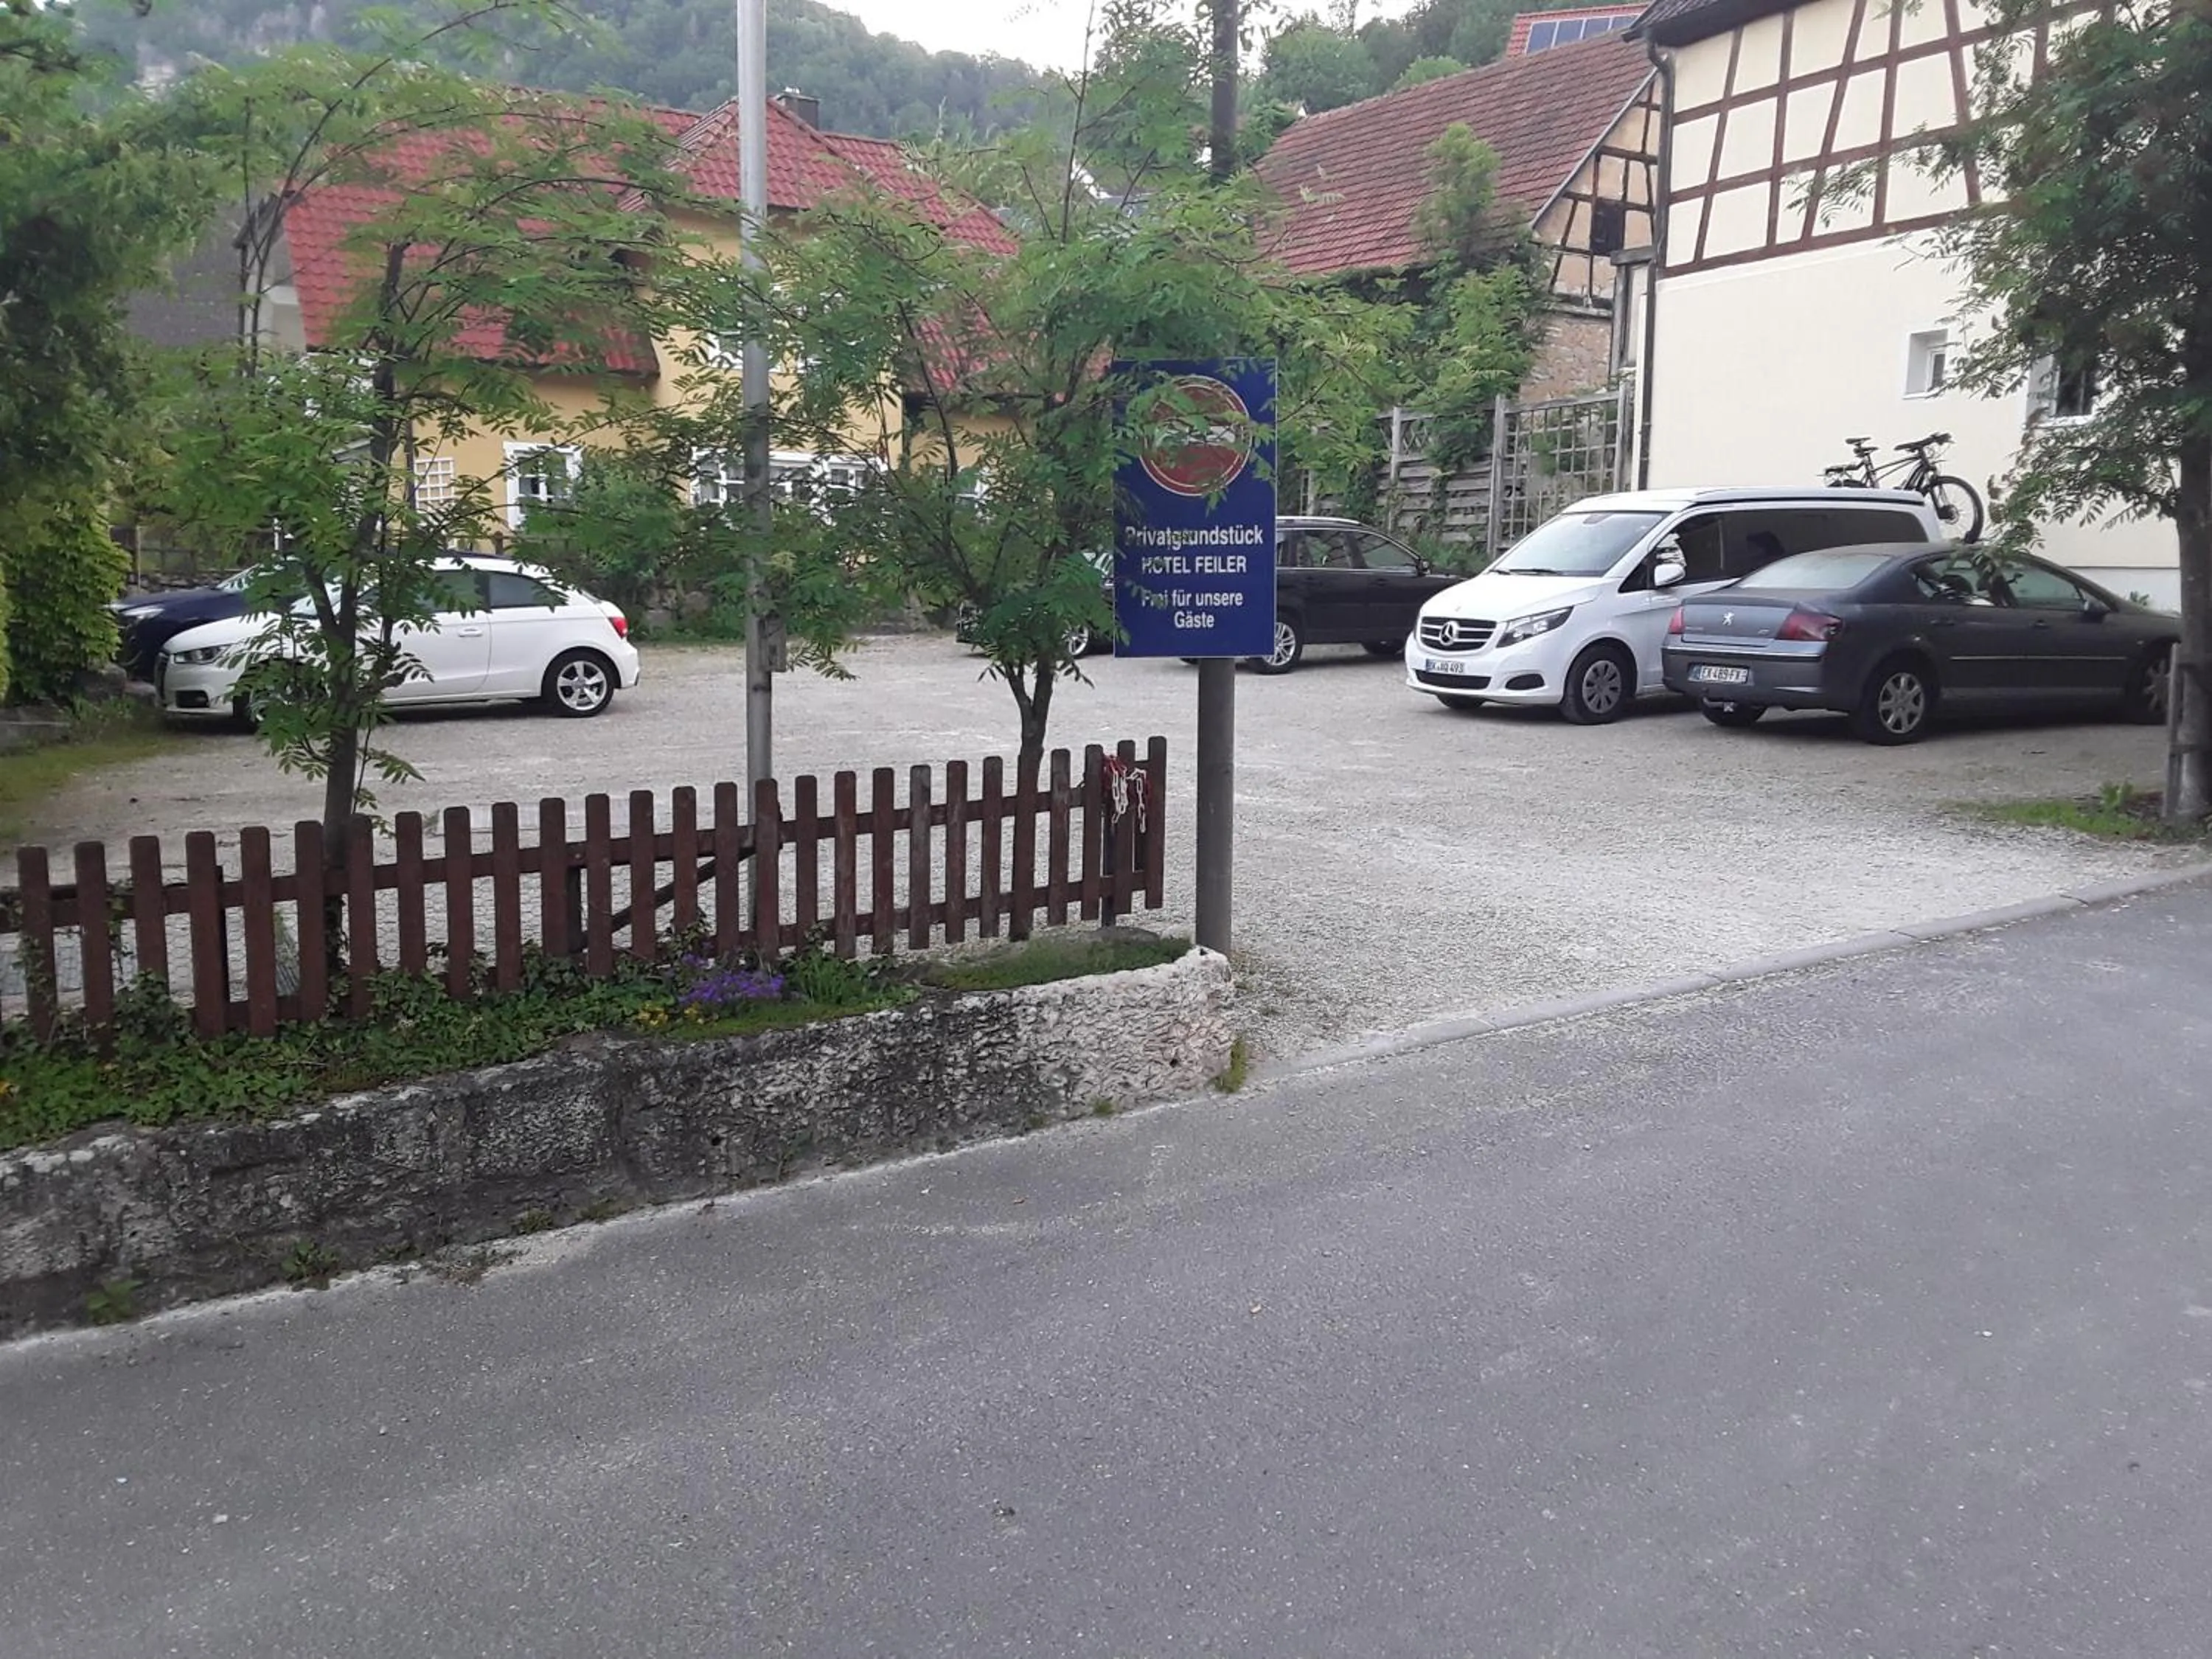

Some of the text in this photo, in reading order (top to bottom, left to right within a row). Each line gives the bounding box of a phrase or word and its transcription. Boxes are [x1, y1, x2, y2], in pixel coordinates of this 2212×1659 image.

[1141, 555, 1247, 574] HOTEL FEILER
[1172, 589, 1192, 607] für
[1195, 592, 1243, 606] unsere
[1174, 611, 1215, 628] Gäste
